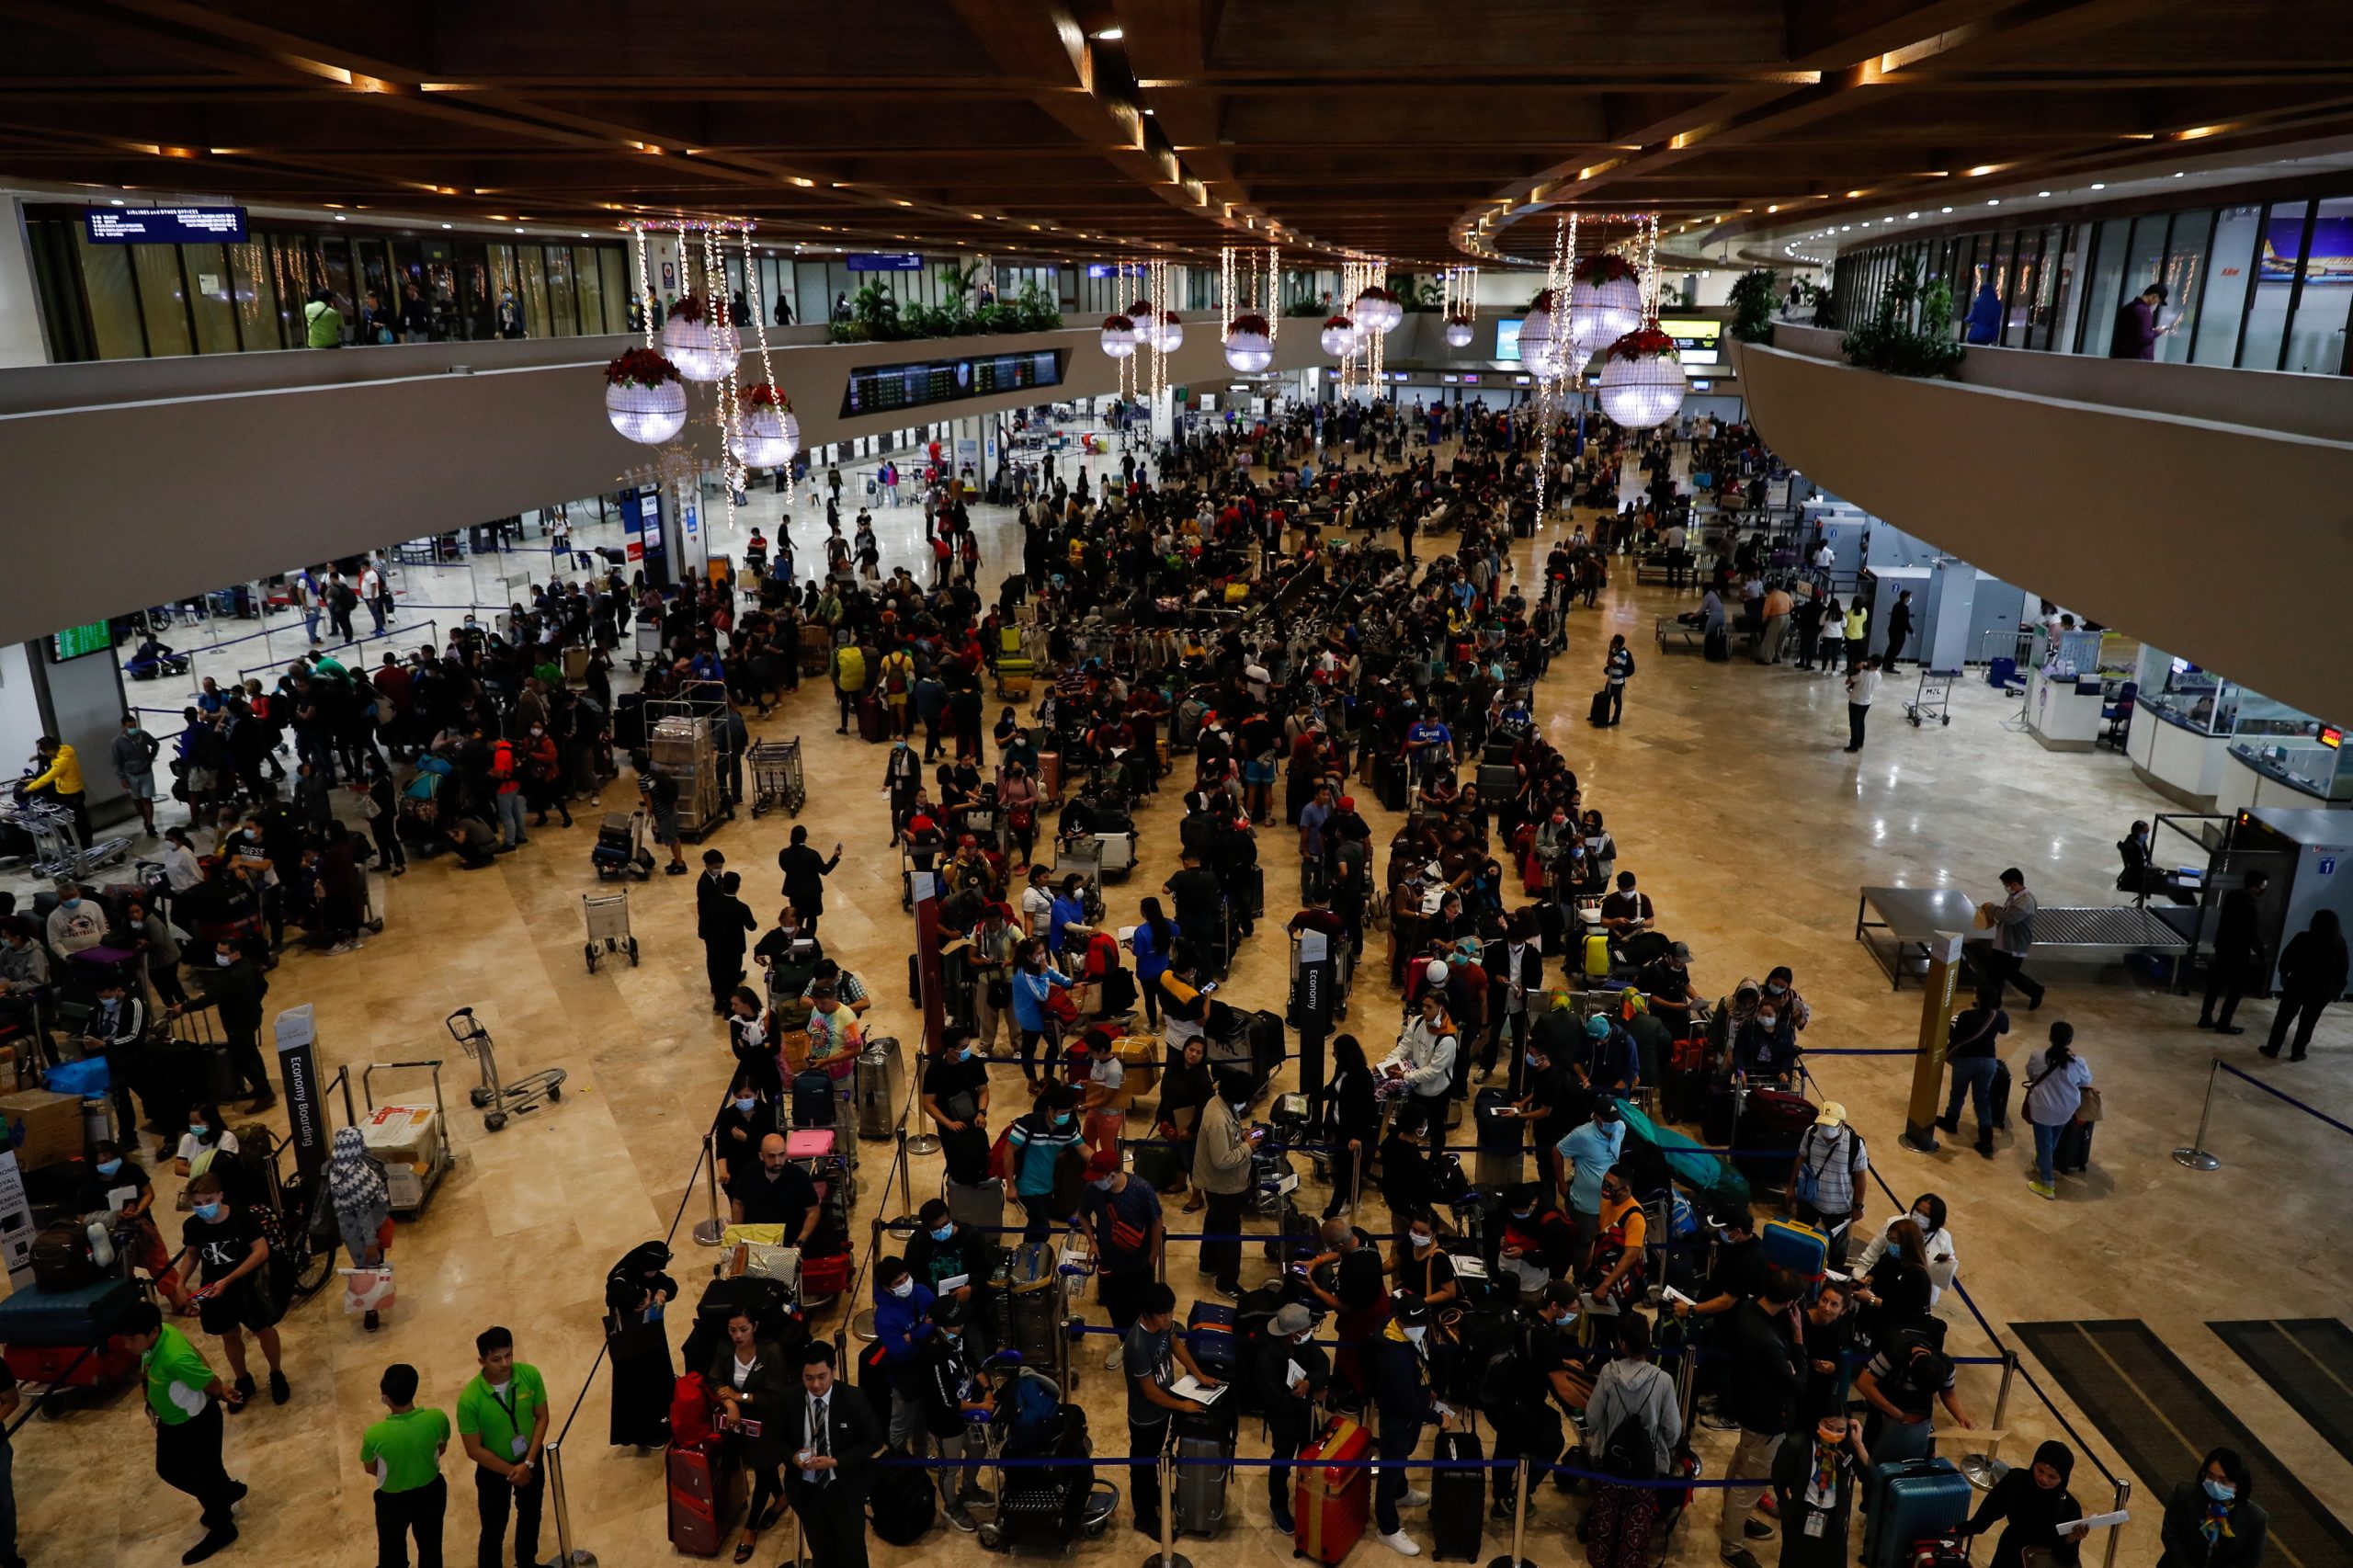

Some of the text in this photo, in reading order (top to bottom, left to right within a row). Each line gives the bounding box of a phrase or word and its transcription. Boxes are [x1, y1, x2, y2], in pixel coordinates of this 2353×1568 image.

[2325, 862, 2330, 873] 1
[1307, 970, 1317, 1010] Economy
[290, 1057, 313, 1147] Economy Boarding
[2, 1227, 34, 1244] BUSINESS
